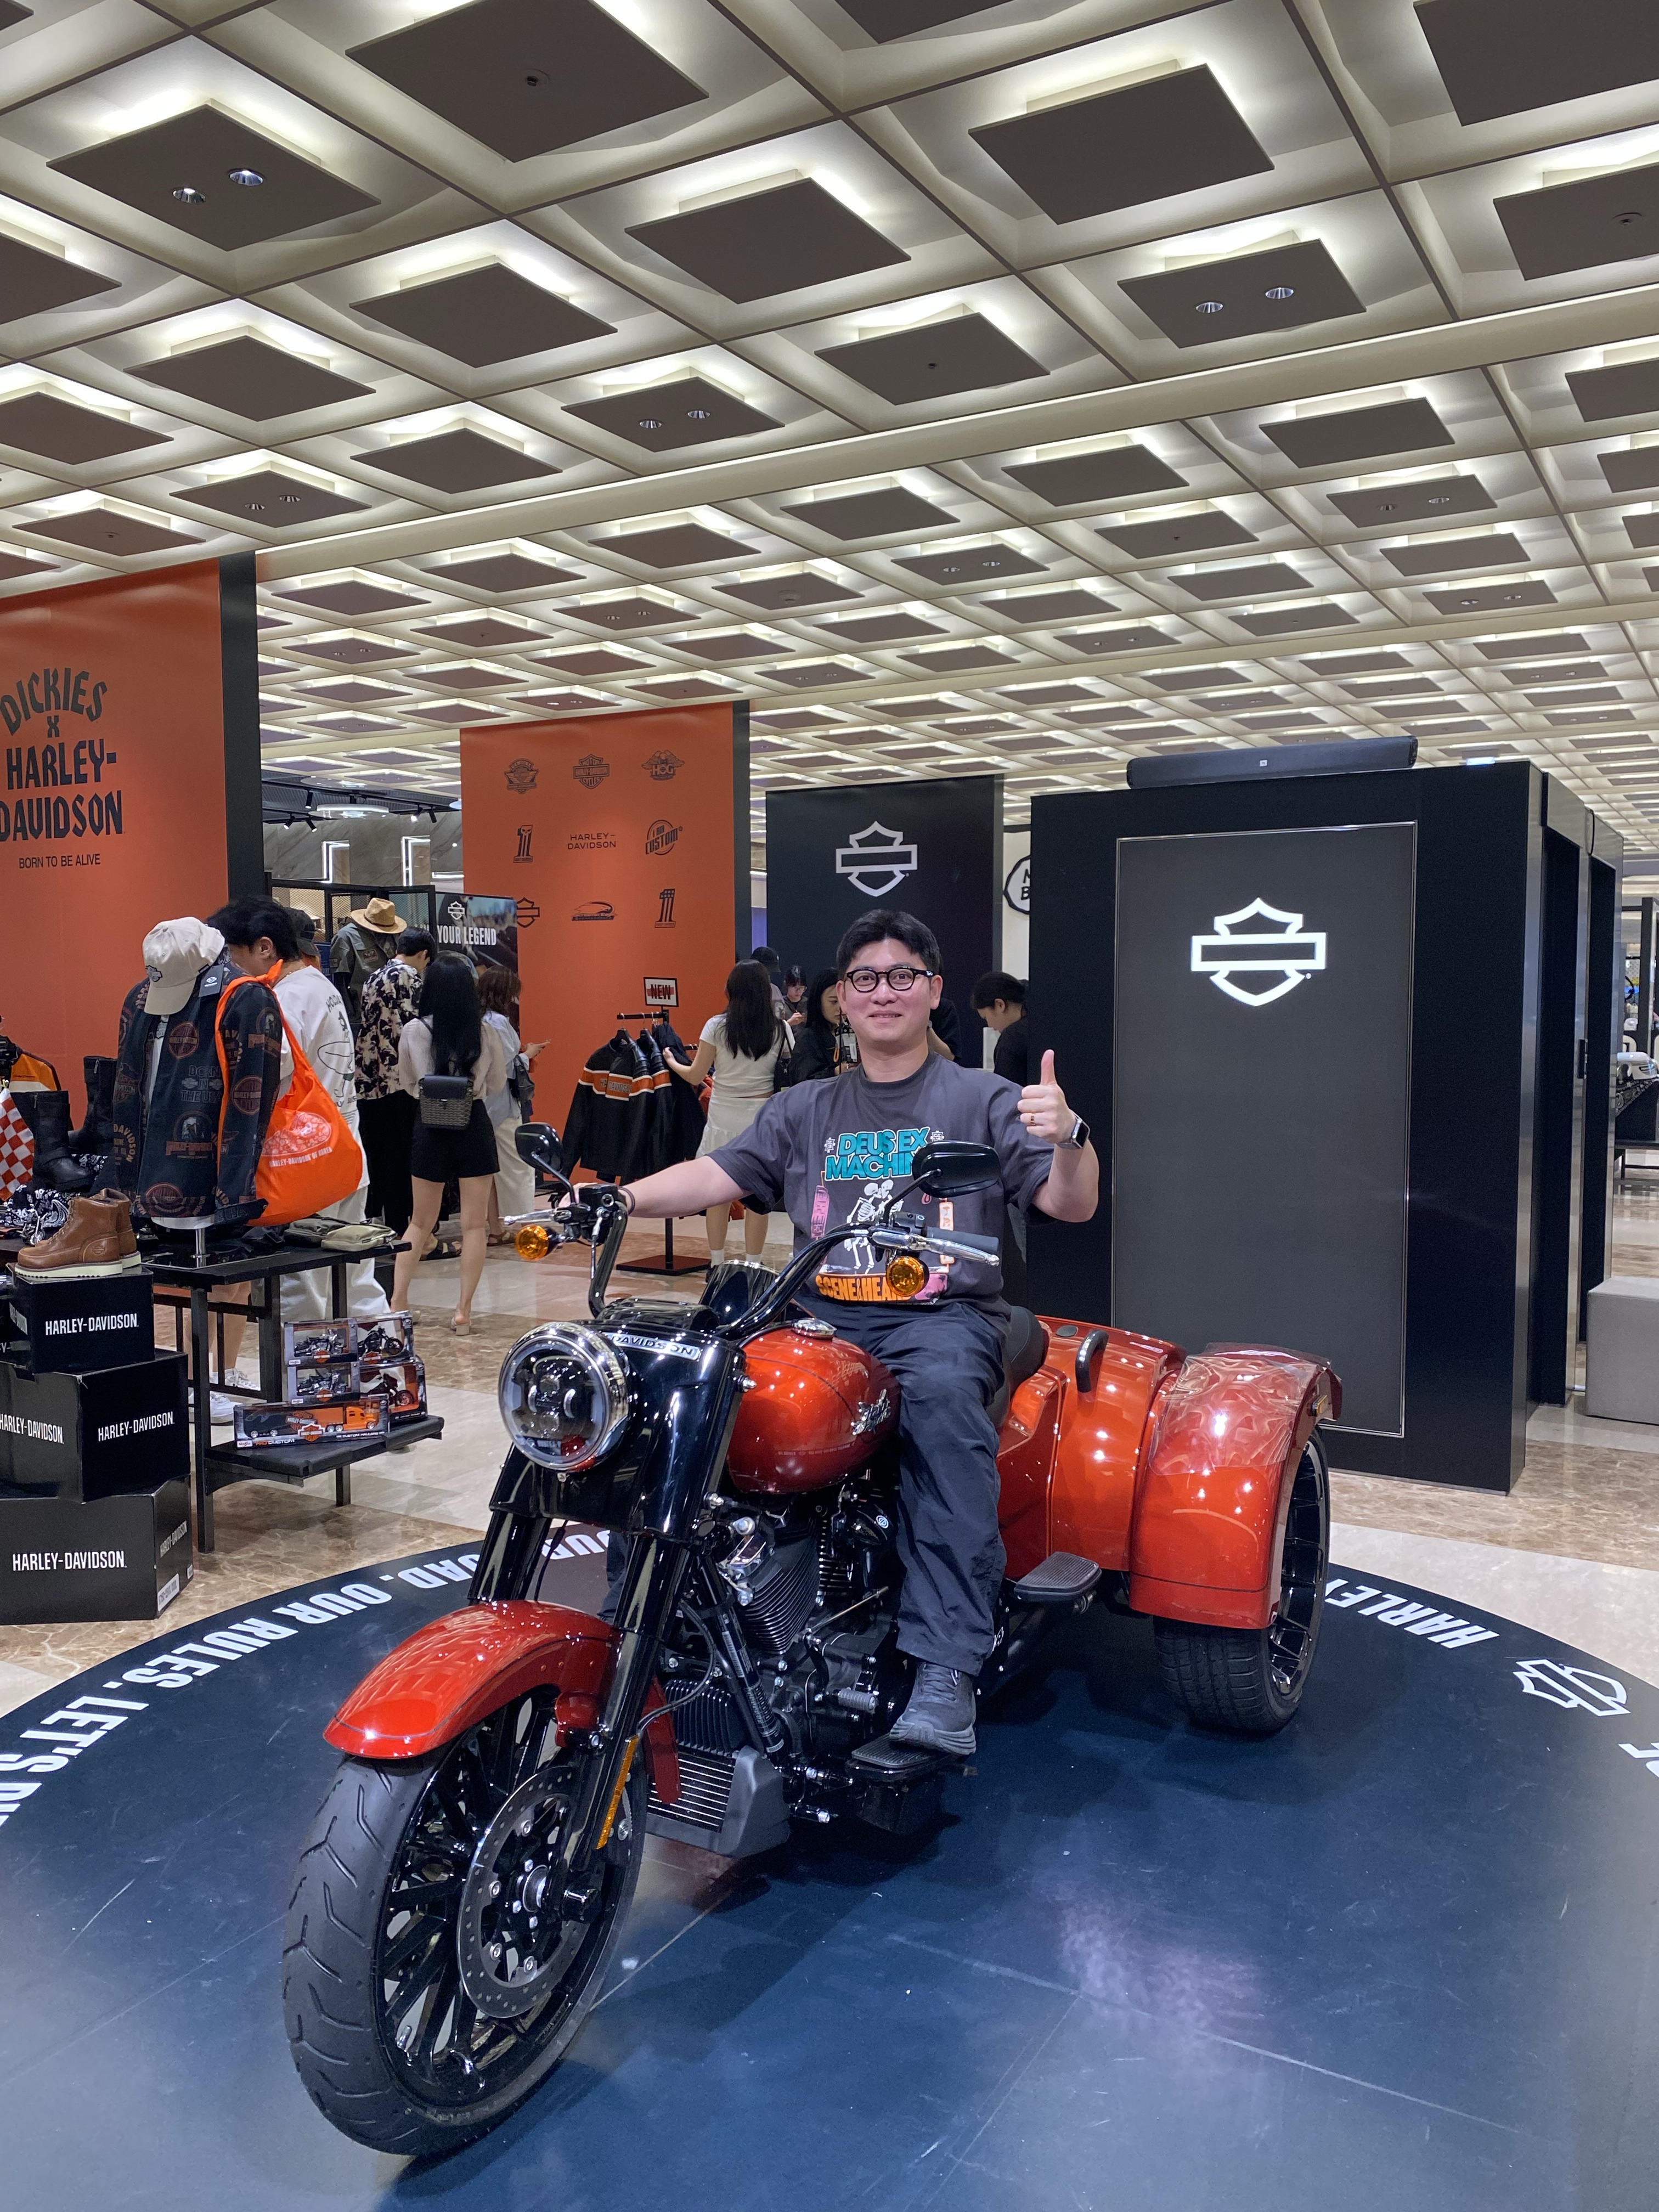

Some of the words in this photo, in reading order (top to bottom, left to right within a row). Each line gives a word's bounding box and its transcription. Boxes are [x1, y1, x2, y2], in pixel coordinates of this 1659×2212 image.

[0, 667, 108, 736] DICKIES
[7, 738, 117, 790] HARLEY-
[0, 790, 123, 842] DAVIDSON
[567, 841, 617, 850] DAVIDSON
[570, 832, 616, 840] HARLEY-
[19, 856, 44, 869] BORN
[46, 856, 58, 867] TO
[61, 855, 74, 867] BE
[76, 854, 101, 866] ALIVE
[437, 925, 462, 944] YOUR
[464, 927, 497, 946] LEGEND
[650, 984, 672, 1000] NEW
[607, 1081, 631, 1093] DAVIDSO
[114, 1124, 137, 1163] DAVIDSON
[837, 1128, 896, 1156] DEUS
[896, 1126, 931, 1153] EX
[825, 1153, 914, 1181] MACHIN
[45, 1313, 138, 1336] HARLEY-DAVIDSON
[0, 1413, 64, 1444] HARLEY-DAVIDSON
[98, 1412, 174, 1442] HARLEY-DAVIDSON
[12, 1550, 125, 1571] HARLEY-DAVIDSON
[272, 1583, 393, 1624] OUR
[102, 1617, 299, 1689] RULES.
